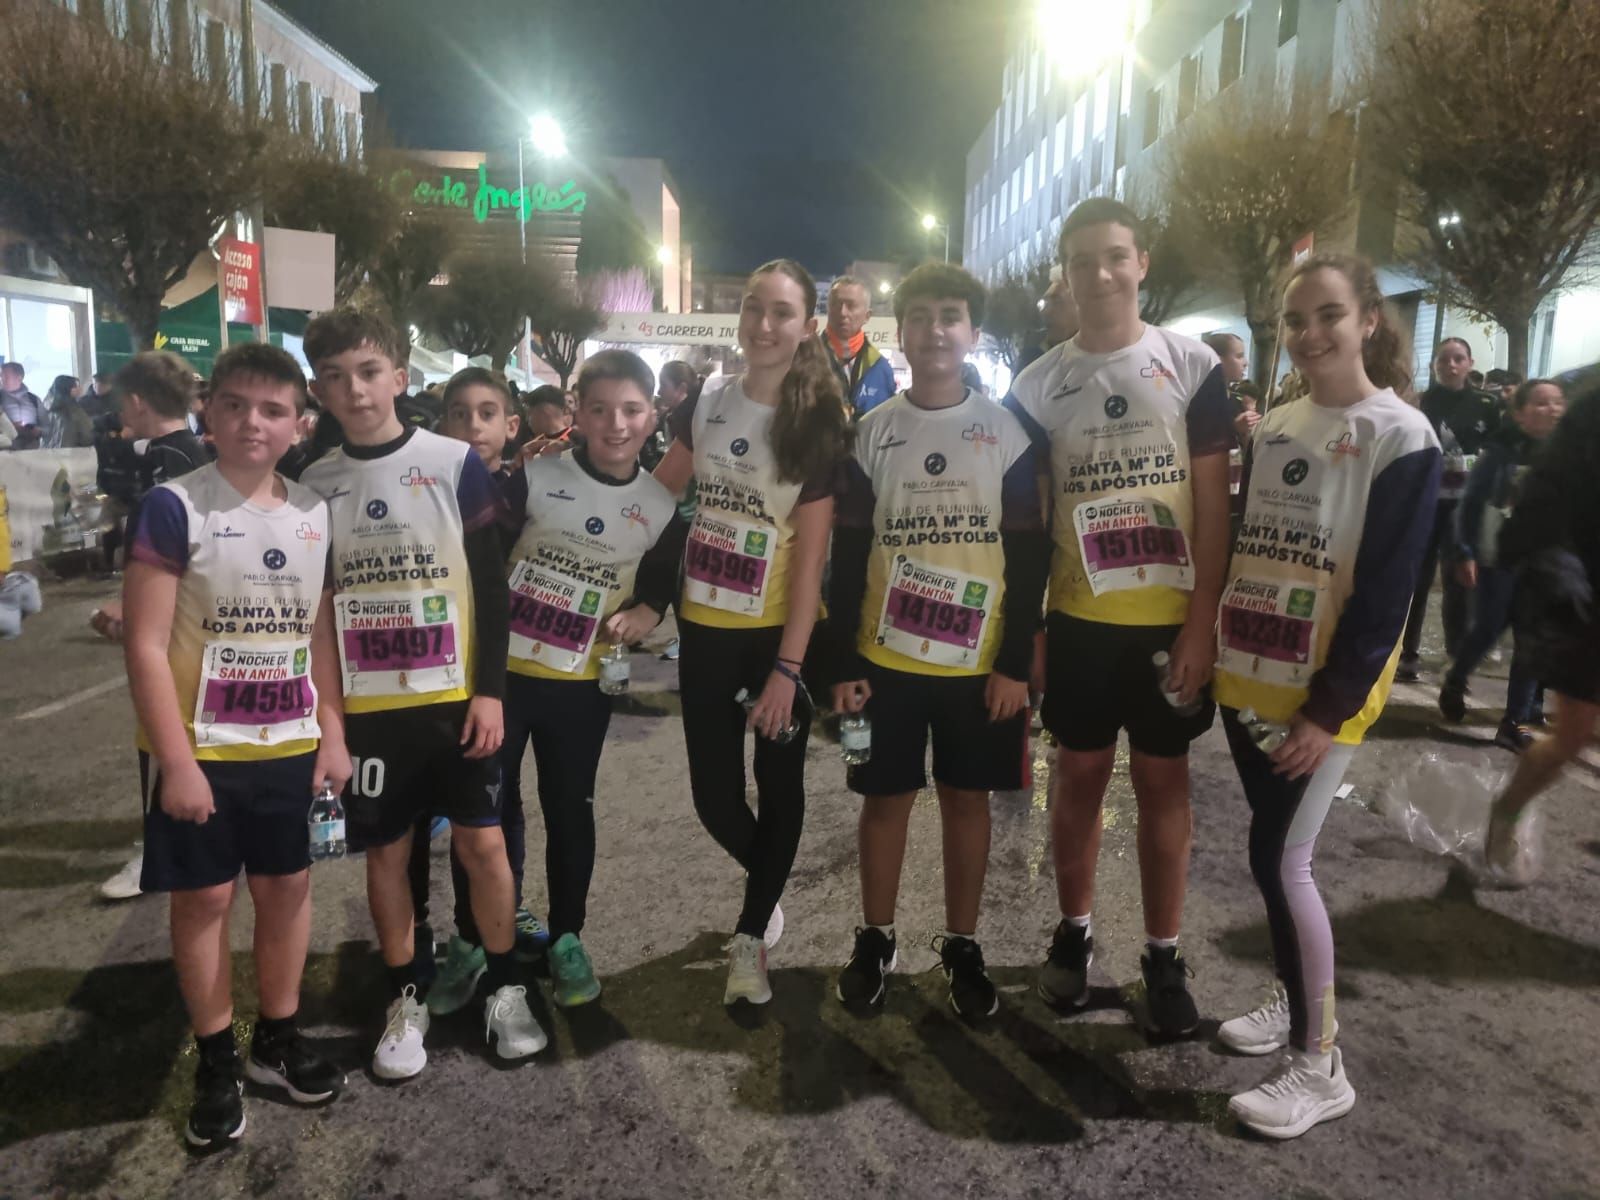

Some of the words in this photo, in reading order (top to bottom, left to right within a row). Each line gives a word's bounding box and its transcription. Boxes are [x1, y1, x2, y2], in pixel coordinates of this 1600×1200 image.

[473, 163, 587, 223] Inglés
[224, 246, 252, 270] Acceso
[225, 268, 248, 292] cajón
[187, 338, 209, 347] RURAL
[657, 325, 713, 337] CARRERA
[718, 327, 740, 338] IN
[872, 331, 889, 342] DE
[1100, 450, 1115, 461] DE
[1121, 444, 1175, 458] RUNNING
[1070, 462, 1122, 478] SANTA
[1155, 454, 1174, 468] DE
[697, 482, 730, 497] ANTA
[1091, 469, 1186, 493] APÓSTOLES
[916, 505, 932, 515] DE
[937, 504, 991, 515] RUNNING
[1099, 505, 1132, 518] NOCHE
[1134, 503, 1145, 514] DE
[352, 524, 371, 534] ABLO
[702, 521, 726, 537] NOCHE
[726, 528, 737, 540] DE
[886, 516, 938, 530] SANTA
[969, 515, 989, 527] DE
[1088, 520, 1110, 533] SAN
[1113, 514, 1149, 529] ANTÓN
[708, 533, 737, 551] ANTÓN
[877, 533, 902, 547] OS
[906, 528, 998, 547] APÓSTOLES
[339, 551, 361, 562] CUB
[364, 547, 375, 557] DE
[382, 543, 436, 557] RUNNING
[344, 556, 384, 572] ANTA
[415, 553, 435, 565] DE
[538, 548, 580, 571] SANTA
[601, 569, 618, 582] DE
[243, 573, 266, 581] PABLO
[336, 577, 355, 590] LS
[357, 567, 449, 585] APÓSTOLES
[913, 570, 942, 587] NOCHE
[945, 580, 957, 590] DE
[517, 583, 538, 596] SAN
[537, 590, 572, 610] ANTÓN
[533, 576, 561, 593] NOCHE
[562, 587, 576, 598] DE
[899, 578, 918, 593] SAN
[918, 585, 954, 602] ANTÓN
[216, 595, 252, 607] CLUB
[255, 597, 270, 606] DE
[363, 604, 395, 615] NOCHE
[398, 603, 412, 614] DE
[218, 606, 276, 619] SANTA
[351, 617, 373, 629] SAN
[375, 614, 413, 628] ANTÓN
[509, 594, 588, 642] 14895
[900, 594, 972, 635] 14193
[202, 618, 237, 634] LOS
[355, 626, 443, 661] 15497
[236, 655, 275, 666] NOCHE
[277, 654, 288, 666] DE
[218, 667, 246, 680] SAN
[248, 667, 288, 681] ANTÓN
[221, 681, 304, 714] 14591
[352, 755, 386, 798] 10
